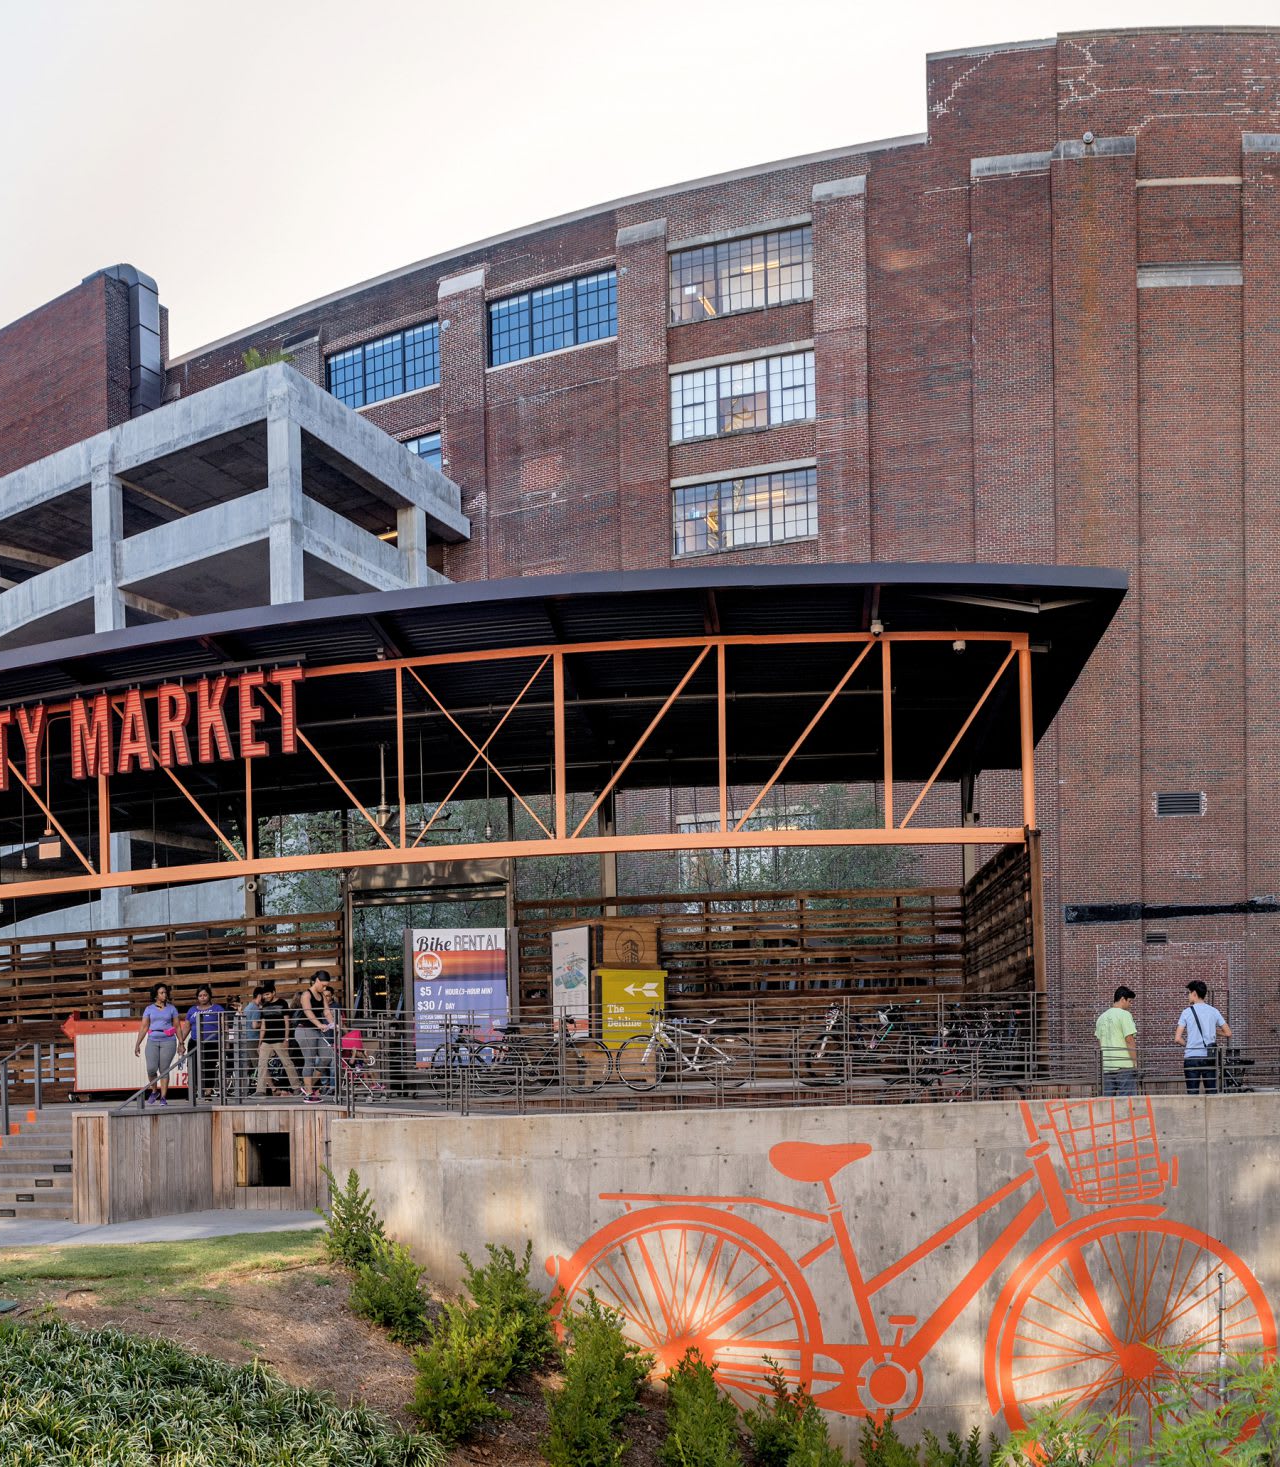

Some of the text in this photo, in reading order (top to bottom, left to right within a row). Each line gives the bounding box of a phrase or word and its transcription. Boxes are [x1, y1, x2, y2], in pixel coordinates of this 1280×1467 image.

[71, 666, 306, 780] MARKET
[416, 934, 503, 952] Bike RENTAL
[420, 986, 432, 997] $5
[417, 1000, 435, 1011] $30
[445, 1002, 455, 1010] DAY
[607, 1004, 625, 1014] The
